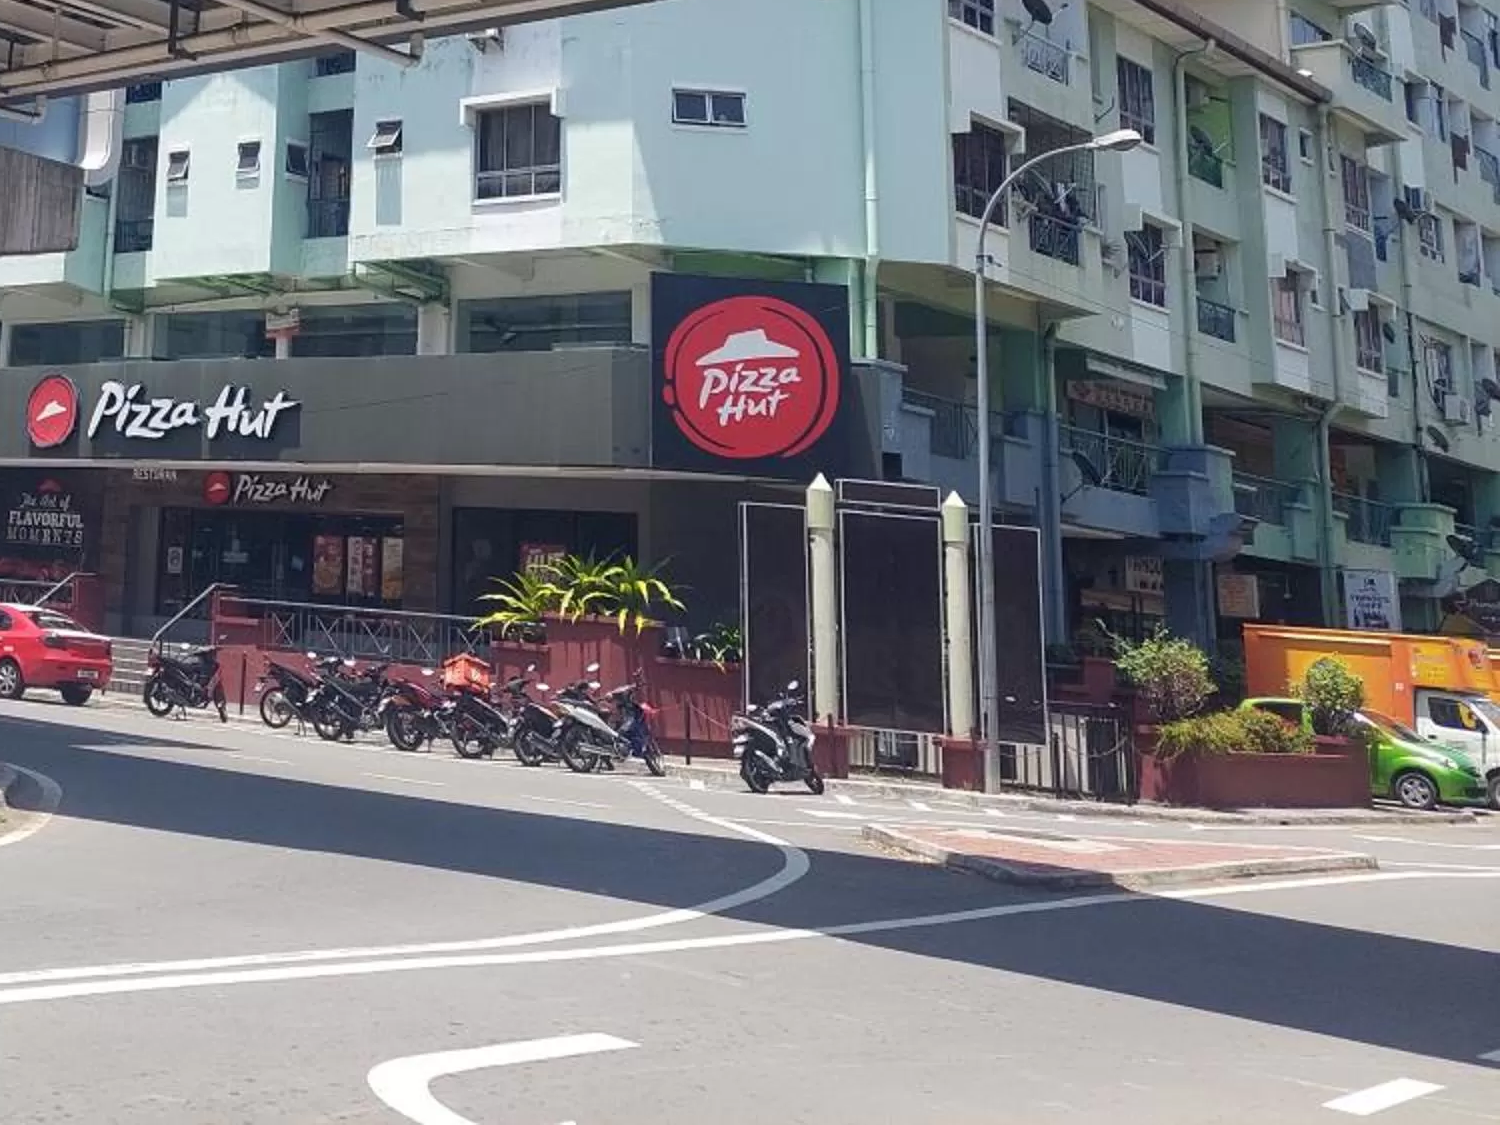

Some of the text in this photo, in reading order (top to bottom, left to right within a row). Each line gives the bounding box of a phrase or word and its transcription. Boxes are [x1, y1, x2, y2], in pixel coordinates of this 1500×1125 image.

[698, 362, 802, 410] Pizza
[87, 380, 302, 439] Pizza Hut
[716, 388, 790, 427] Hut
[234, 474, 331, 504] Pizza Hut
[8, 510, 84, 529] FLAVORFUL
